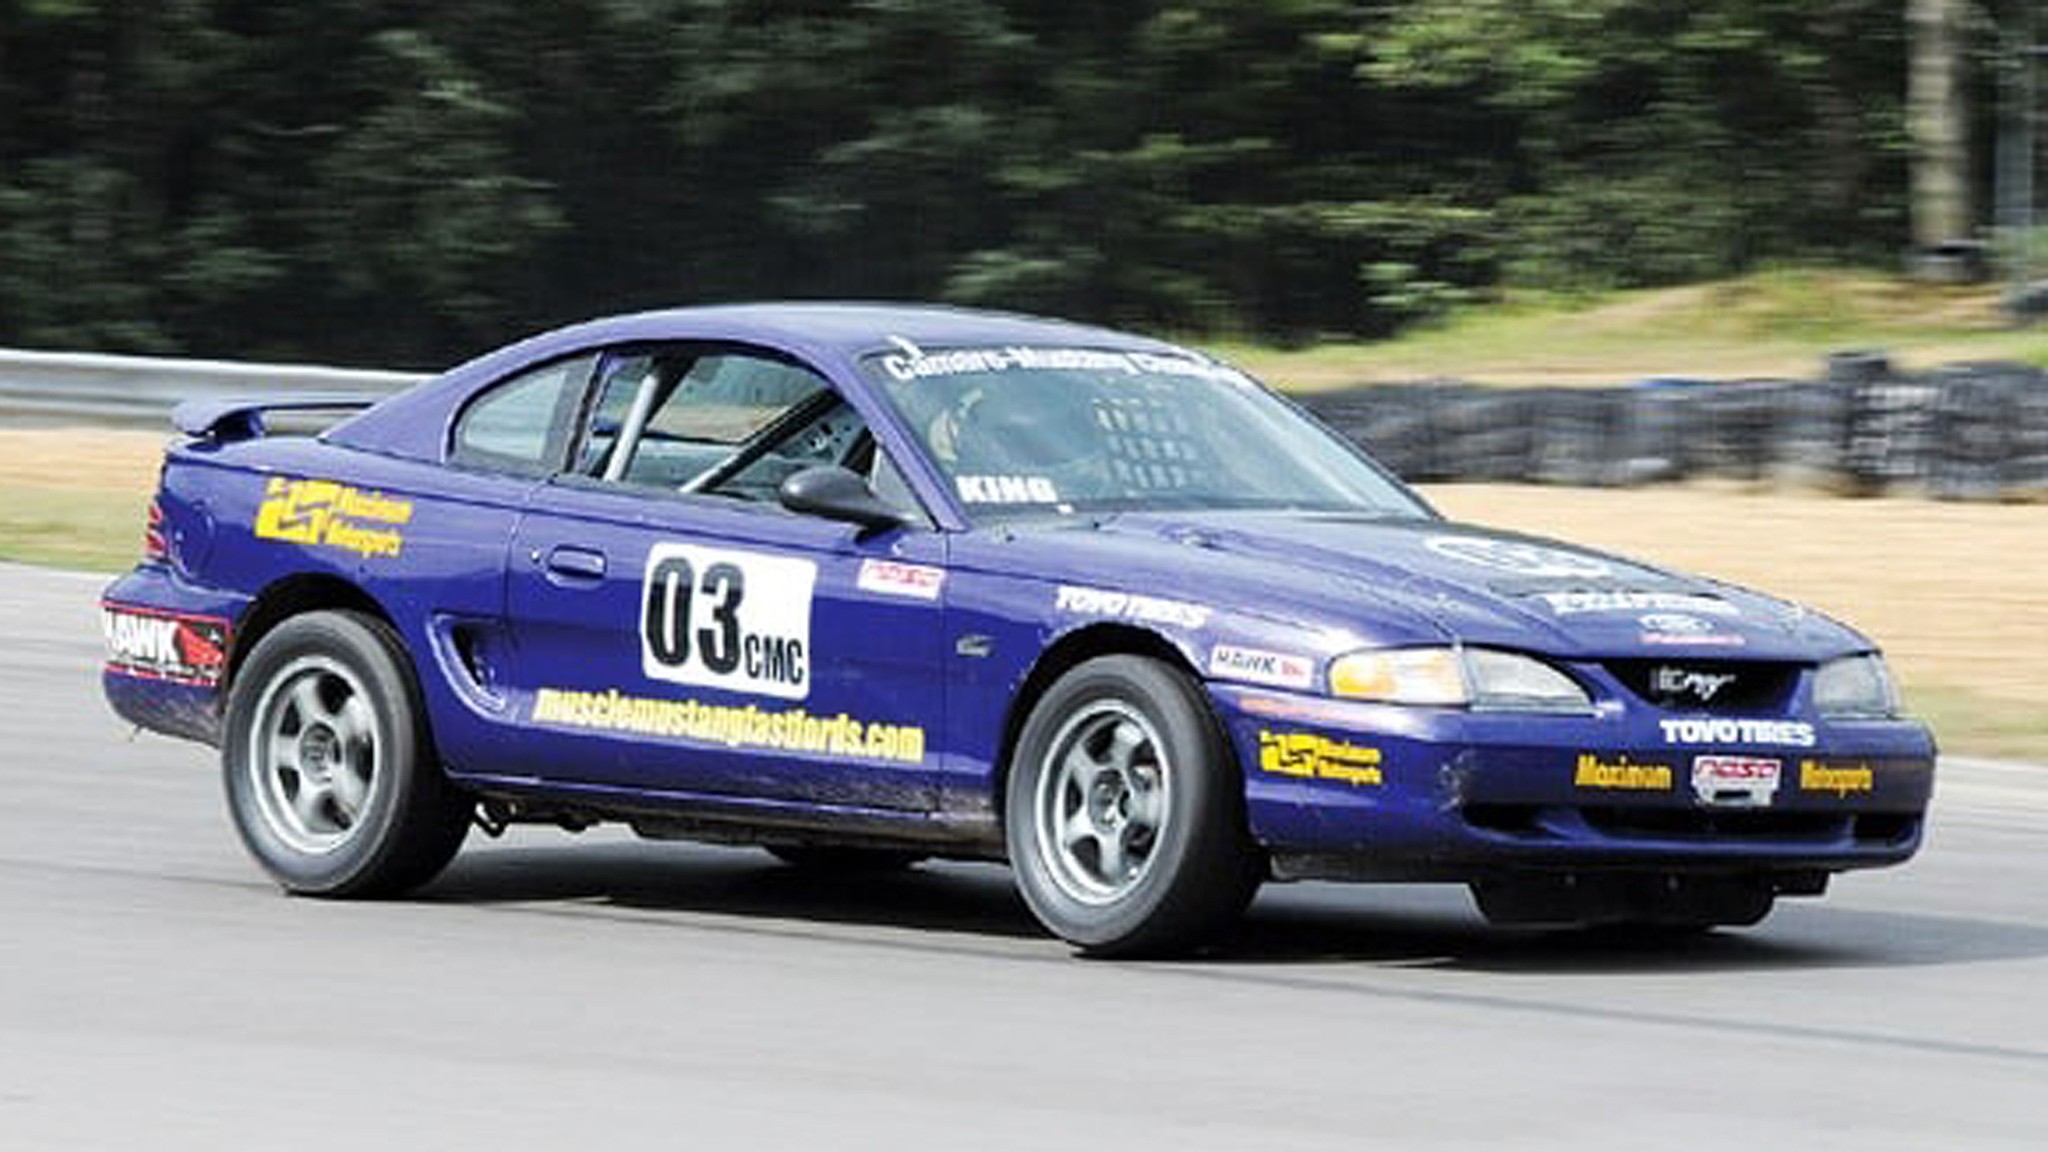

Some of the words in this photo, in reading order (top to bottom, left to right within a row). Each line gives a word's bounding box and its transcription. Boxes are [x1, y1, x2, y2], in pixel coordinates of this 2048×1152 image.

[956, 475, 1059, 502] KING
[645, 556, 744, 675] 03
[744, 632, 804, 686] CMC
[531, 688, 924, 762] musclemustangfastfords.com
